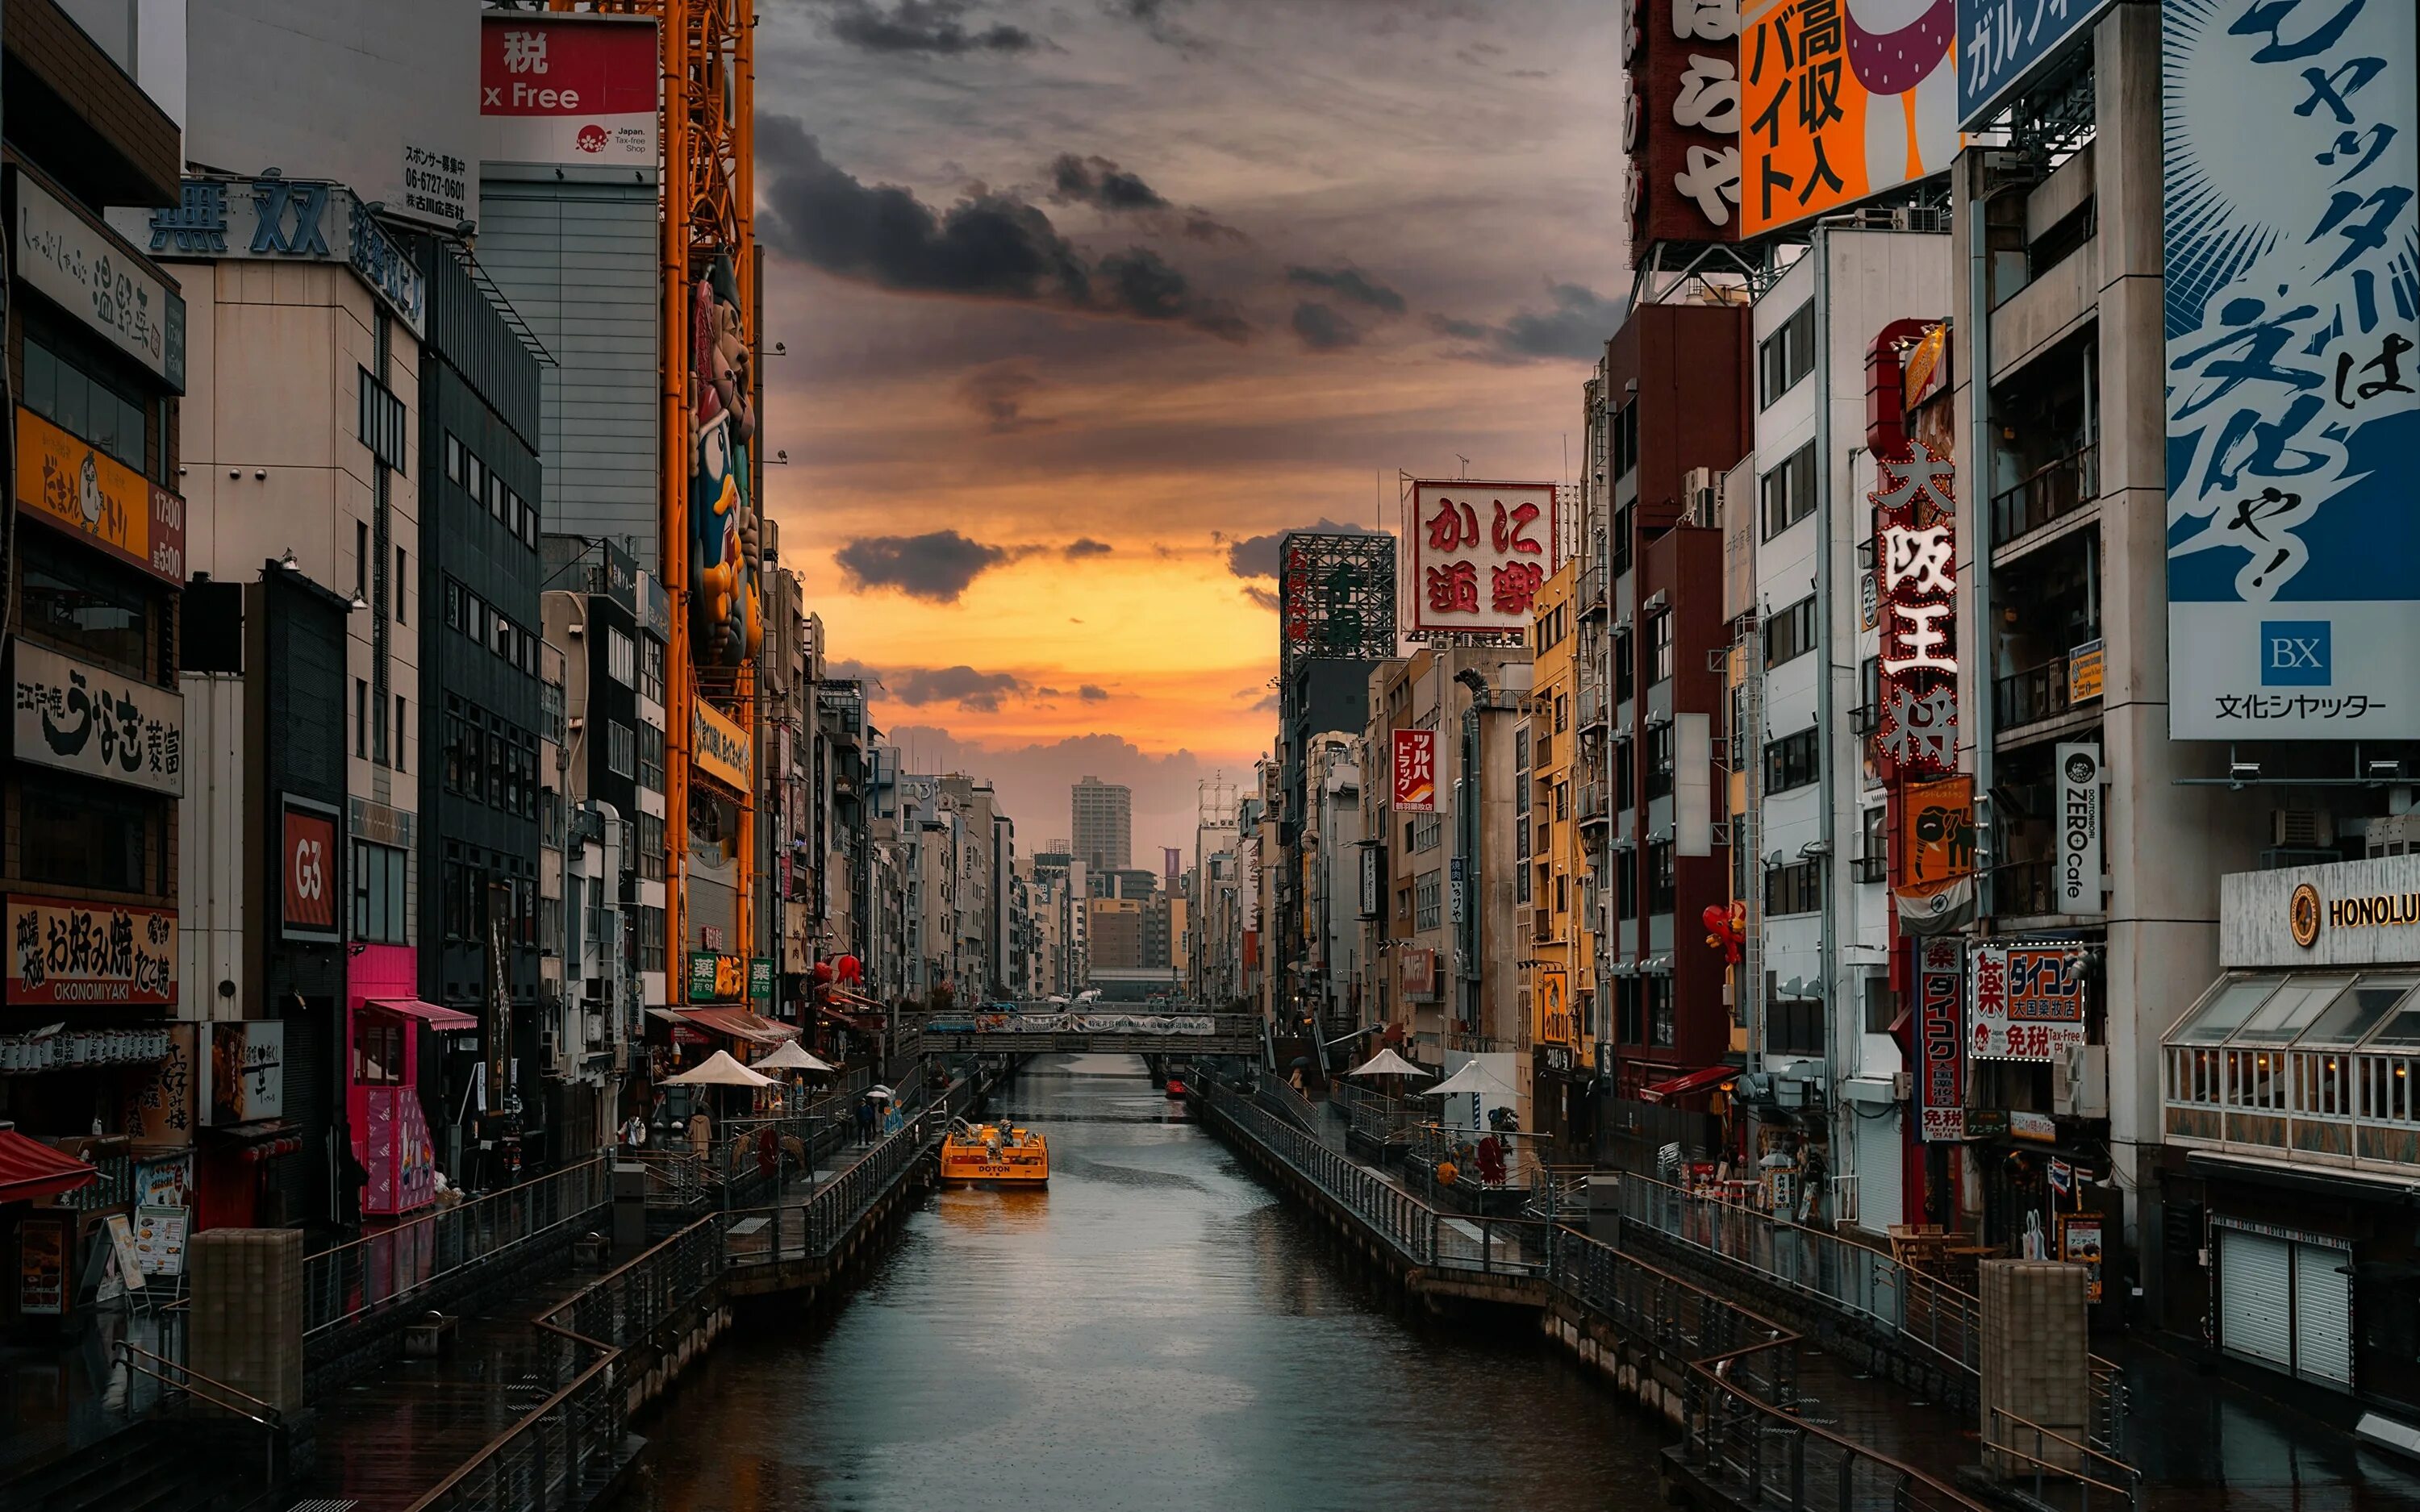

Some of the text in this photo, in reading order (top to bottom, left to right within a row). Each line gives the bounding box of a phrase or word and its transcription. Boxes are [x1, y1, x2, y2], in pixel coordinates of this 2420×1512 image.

[503, 31, 549, 74] 税
[513, 82, 580, 109] Free
[1749, 4, 1795, 222] バイト
[1797, 0, 1845, 207] 高収入
[615, 136, 645, 145] Tax-free
[618, 127, 645, 136] Japan.
[626, 145, 645, 153] Shop
[406, 145, 465, 177] スポンサー募集中
[406, 167, 465, 201] 06-6727-0601
[149, 181, 331, 255] 無双
[23, 206, 87, 285] しゃぶしゃぶ
[92, 255, 150, 350] 温野菜
[155, 490, 181, 531] 17:00
[1425, 498, 1543, 556] かに
[1871, 440, 1959, 769] 大阪王将
[2270, 638, 2324, 668] BX
[17, 681, 65, 719] 江戸焼
[42, 669, 144, 773] うなぎ
[1398, 742, 1412, 791] ドラッグ
[1413, 735, 1430, 781] ツルハ
[2067, 788, 2088, 852] ZERO
[2088, 789, 2096, 839] DOUTONBORI
[295, 838, 322, 901] G3
[1452, 860, 1462, 881] 焼肉
[1452, 882, 1462, 922] いろりや
[2329, 891, 2420, 927] HONOLU
[47, 908, 133, 977] お好み焼
[23, 948, 45, 992] 大阪
[134, 943, 170, 999] たこ焼
[694, 958, 714, 978] 薬
[1976, 958, 2005, 1016] 薬
[2010, 955, 2079, 998] ダイコク
[54, 982, 129, 1001] OKONOMIYAKI
[1927, 974, 1957, 1061] ダイコク
[2048, 1028, 2080, 1043] Tax-Free
[2005, 1024, 2050, 1057] 免税
[161, 1043, 191, 1131] お好み焼
[1923, 1110, 1963, 1127] 免税
